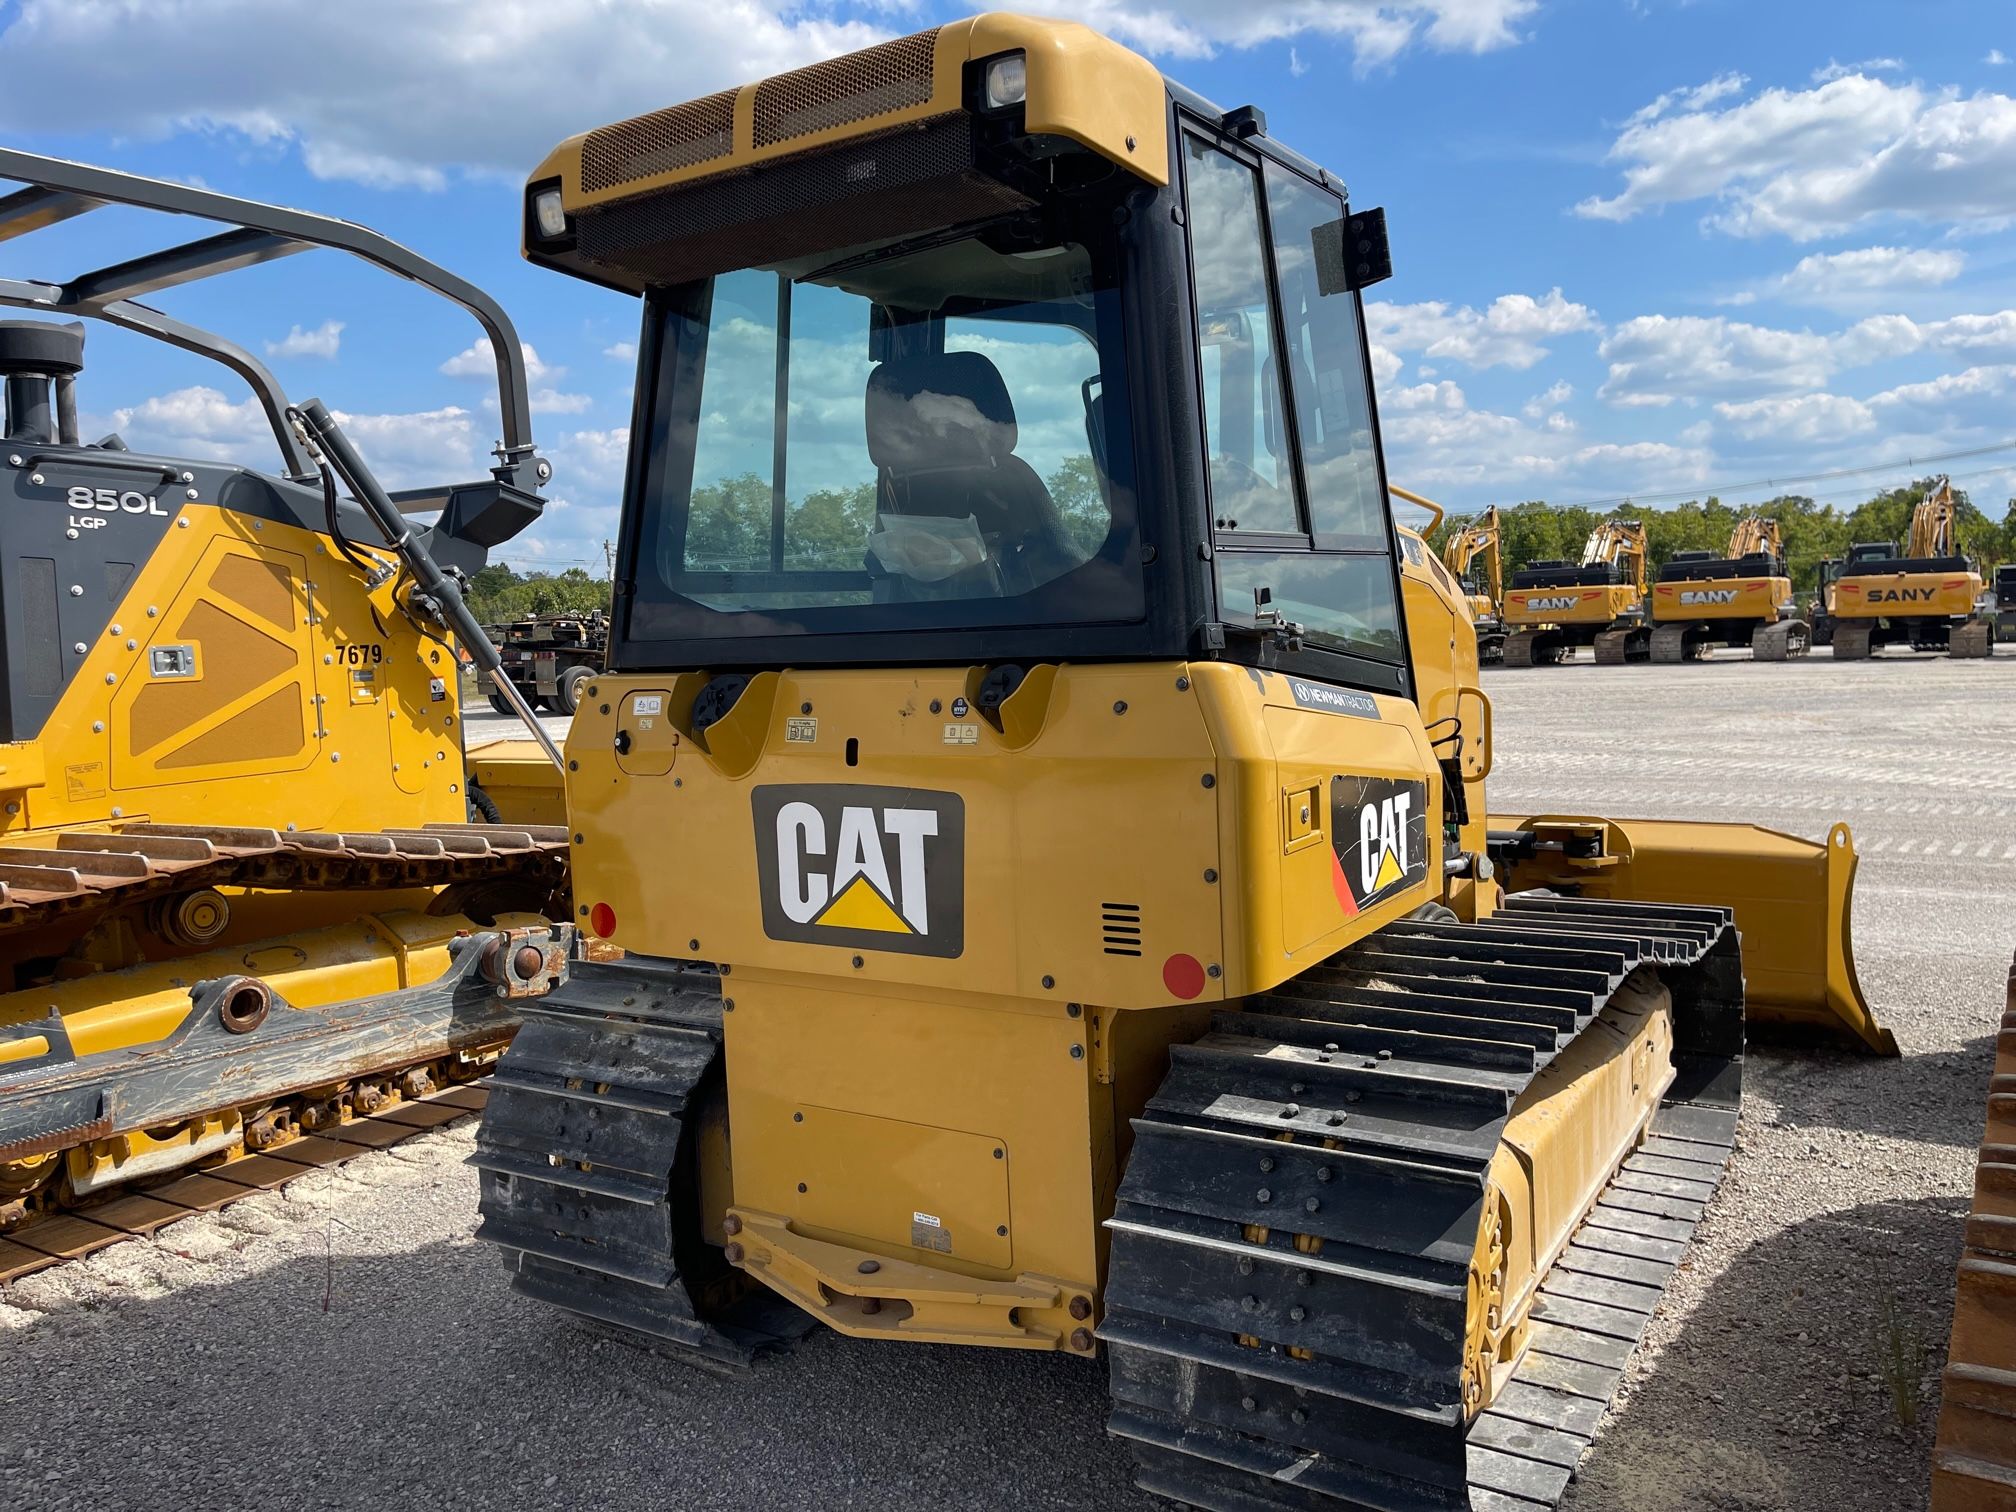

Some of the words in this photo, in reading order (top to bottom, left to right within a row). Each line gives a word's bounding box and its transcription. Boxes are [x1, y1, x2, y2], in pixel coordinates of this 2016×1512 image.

[67, 486, 169, 516] 850L
[69, 515, 108, 530] LGP
[1680, 590, 1738, 606] SANY
[1866, 588, 1937, 602] SANY
[1526, 597, 1579, 612] SANY
[335, 644, 382, 665] 7679
[1360, 791, 1411, 894] CAT
[776, 801, 938, 936] CAT
